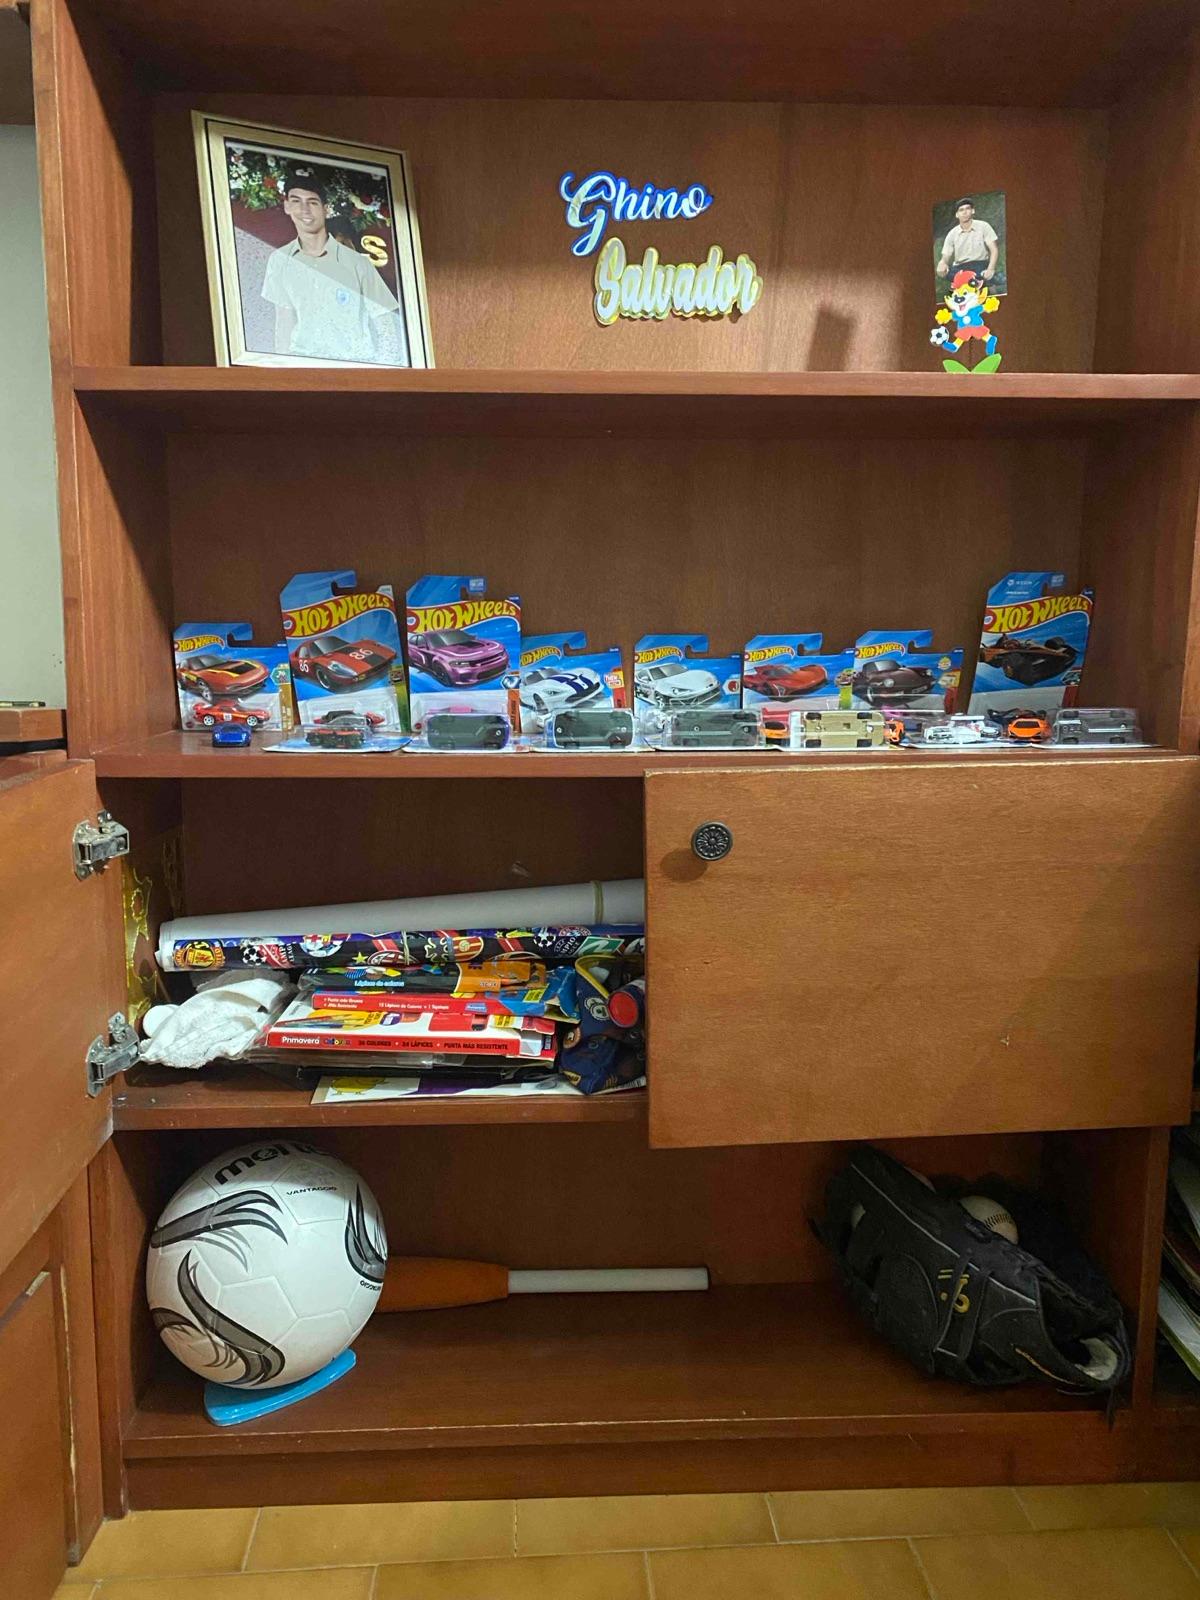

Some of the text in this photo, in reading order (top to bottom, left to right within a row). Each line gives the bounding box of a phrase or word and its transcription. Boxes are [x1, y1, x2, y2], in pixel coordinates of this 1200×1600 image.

[560, 171, 713, 257] Ghino
[595, 237, 764, 326] Salvador
[281, 1035, 321, 1045] Primavera
